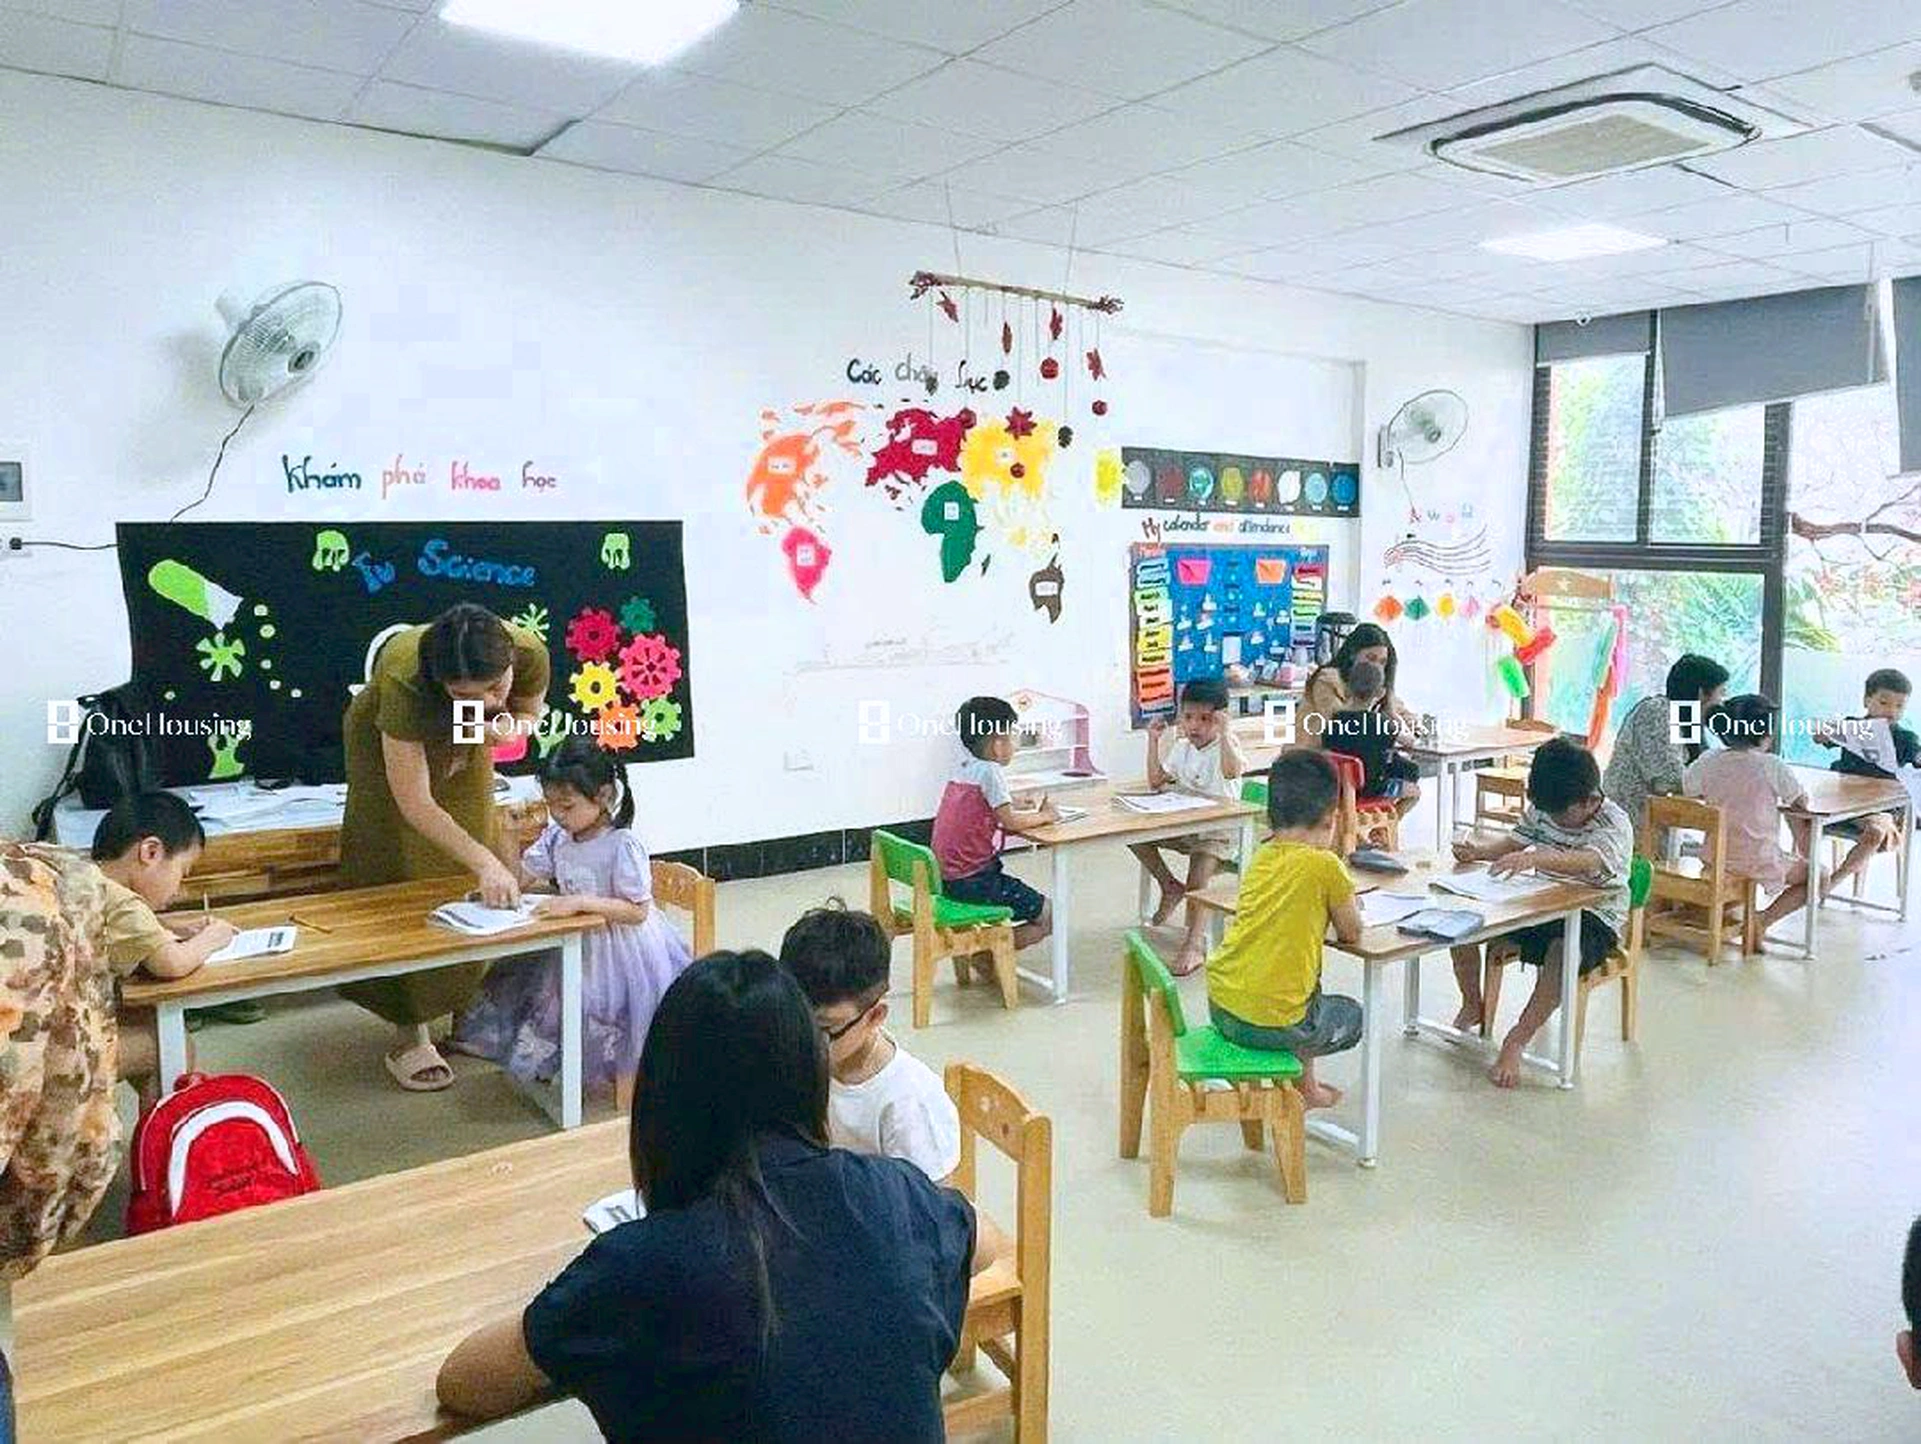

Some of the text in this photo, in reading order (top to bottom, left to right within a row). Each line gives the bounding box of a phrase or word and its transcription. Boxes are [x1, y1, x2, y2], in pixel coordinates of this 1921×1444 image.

[894, 352, 938, 384] châ
[382, 453, 426, 500] phá
[451, 460, 501, 491] khoa
